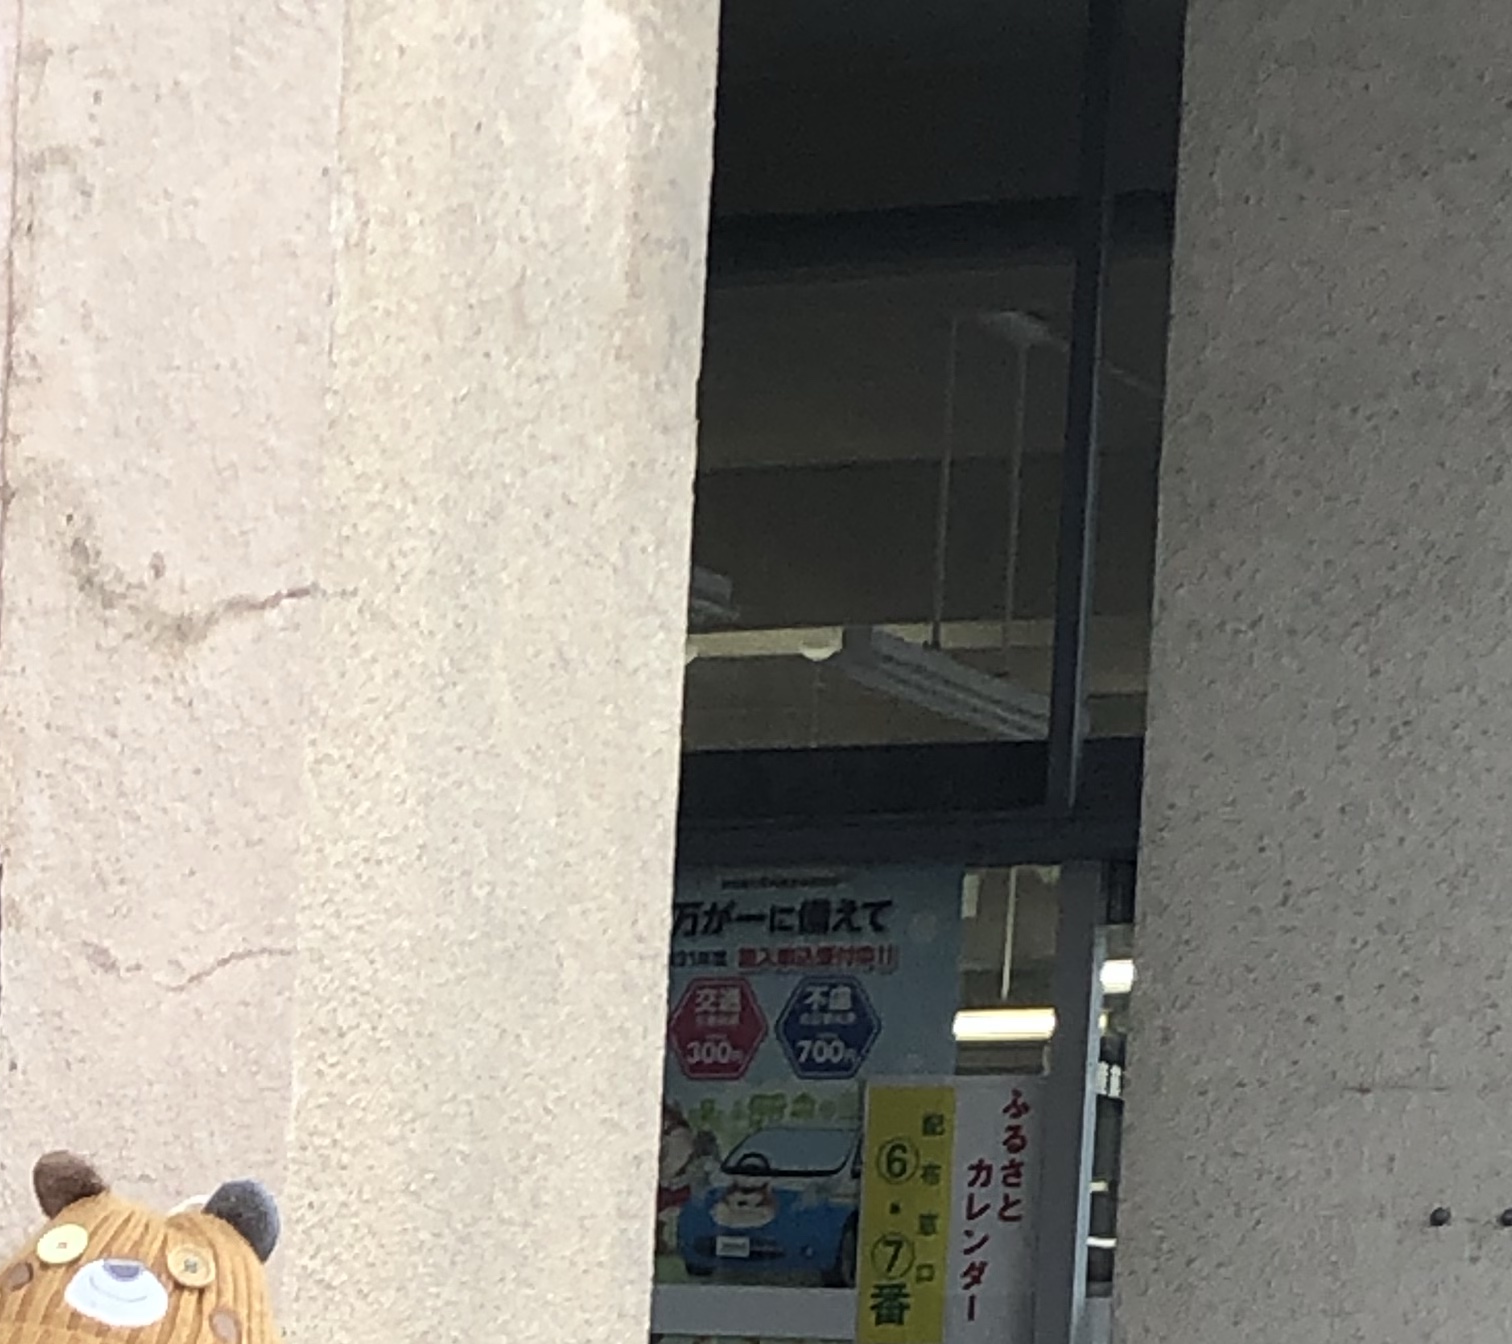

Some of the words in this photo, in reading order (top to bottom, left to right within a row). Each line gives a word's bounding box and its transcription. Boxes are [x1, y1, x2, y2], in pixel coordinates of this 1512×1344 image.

[998, 1088, 1030, 1222] ふるさと
[959, 1158, 993, 1322] カレンダー
